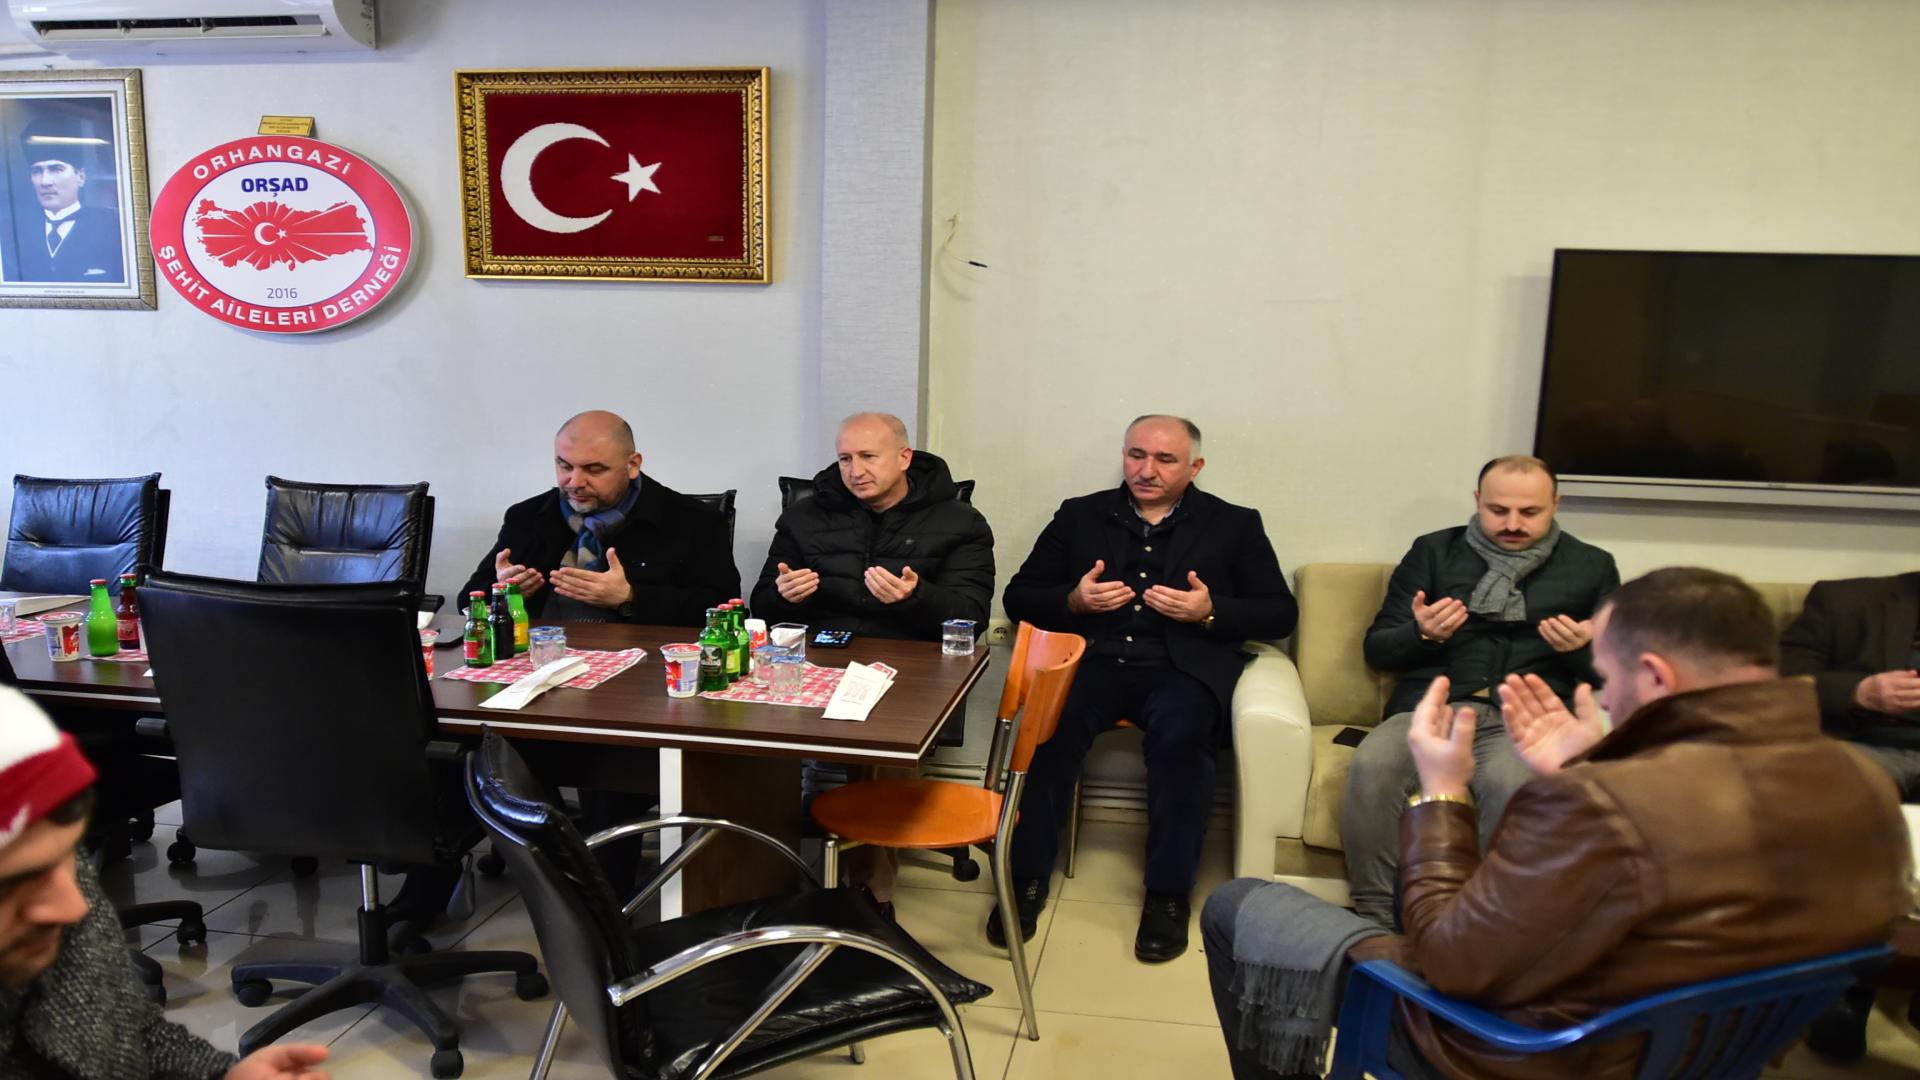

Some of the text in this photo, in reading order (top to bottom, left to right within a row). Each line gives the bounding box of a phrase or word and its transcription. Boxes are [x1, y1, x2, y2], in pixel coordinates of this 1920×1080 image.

[193, 144, 351, 180] ORHANGAZİ
[241, 177, 309, 197] ORŞAD
[158, 245, 402, 326] ŞEHİT AİLELERİ DERNEĞİ
[267, 287, 298, 299] 2016
